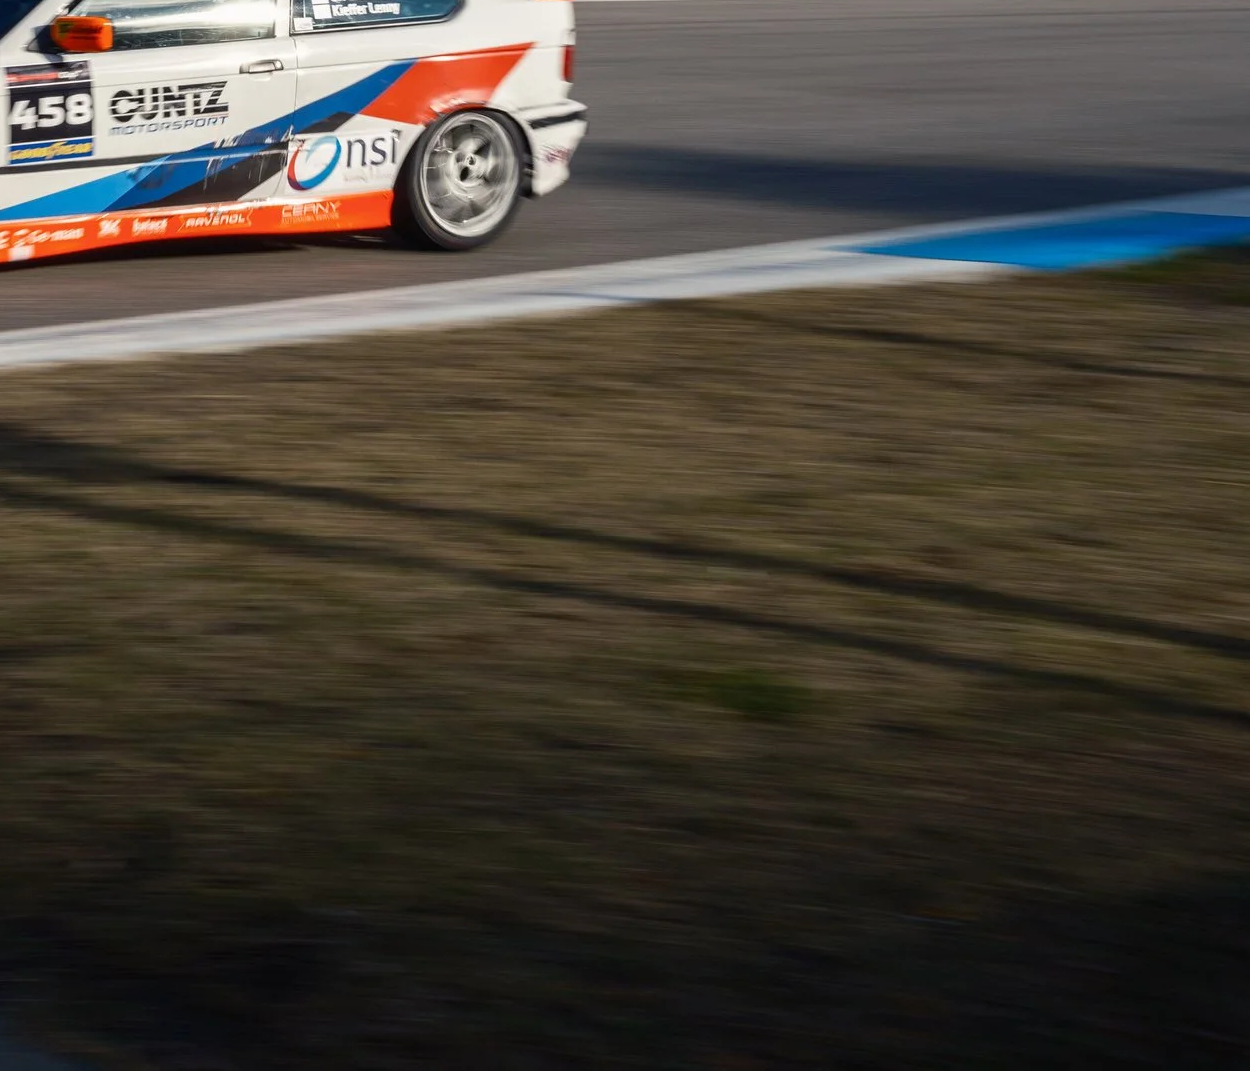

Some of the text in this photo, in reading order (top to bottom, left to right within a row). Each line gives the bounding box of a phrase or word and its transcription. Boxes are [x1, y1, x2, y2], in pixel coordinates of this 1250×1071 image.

[7, 93, 94, 130] 458
[109, 116, 229, 136] MOTORSPORT
[185, 213, 246, 228] RAVENOL
